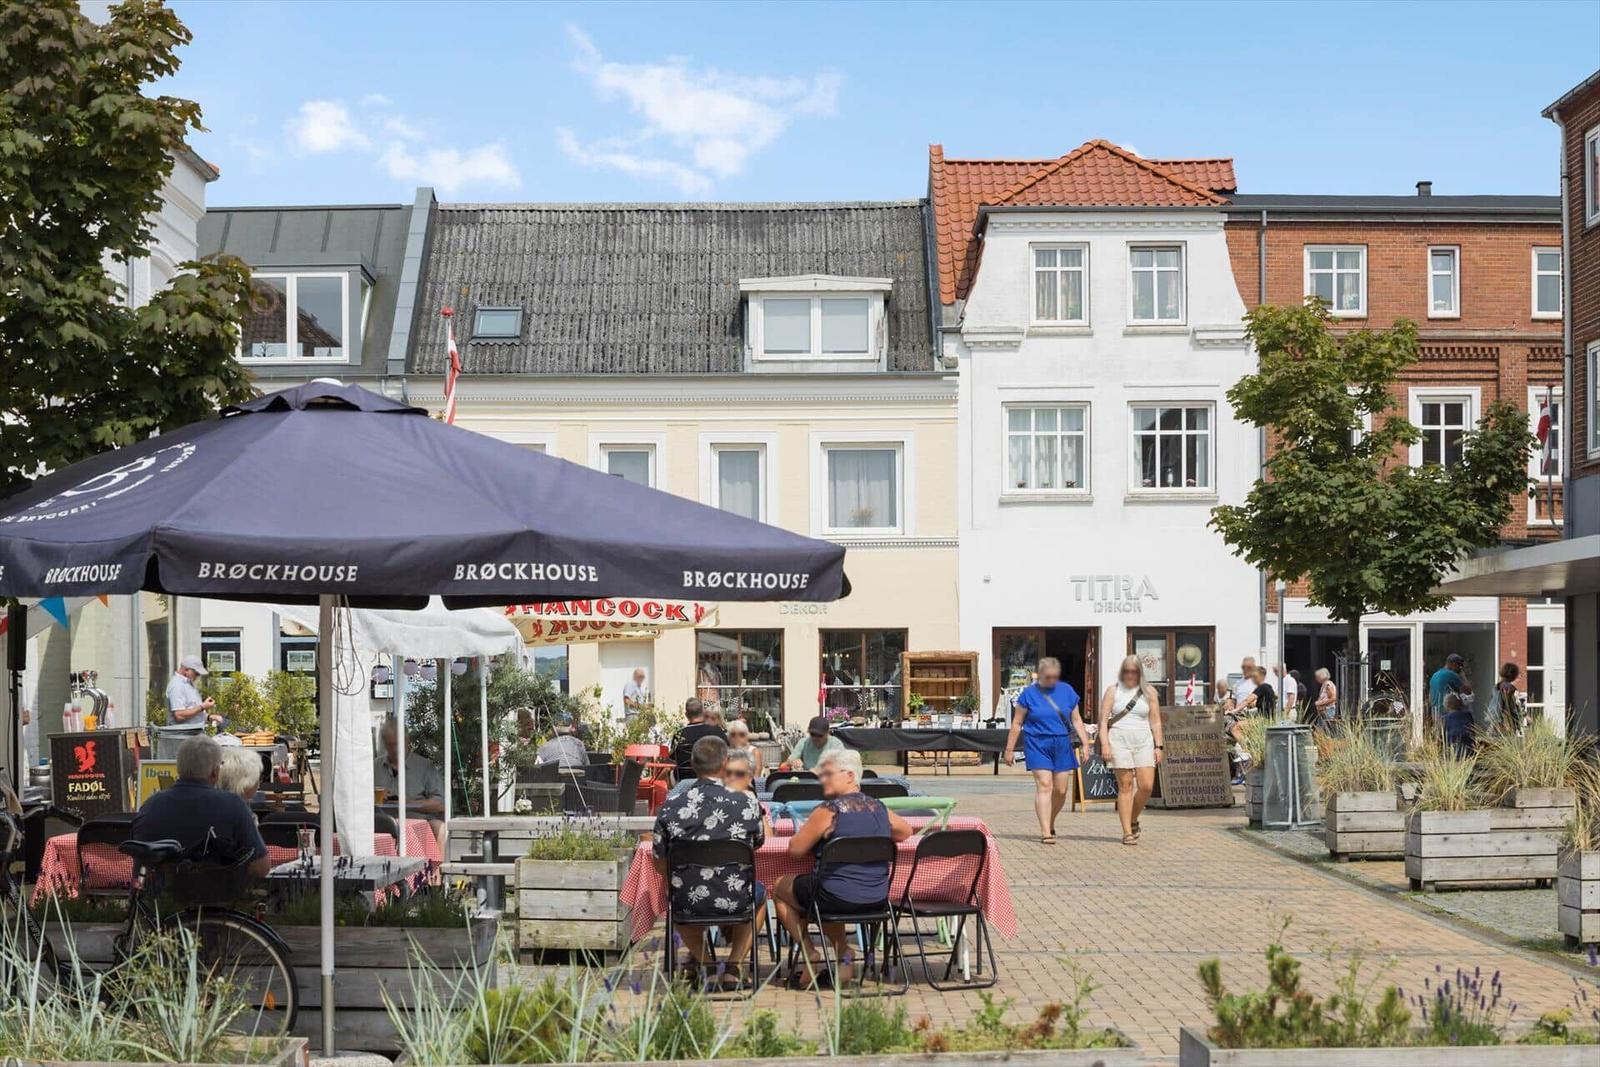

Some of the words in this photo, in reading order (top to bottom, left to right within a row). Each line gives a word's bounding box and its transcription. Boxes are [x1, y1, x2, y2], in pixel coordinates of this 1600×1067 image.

[45, 564, 122, 584] BRØCKHOUSE
[198, 562, 358, 582] BRØCKHOUSE
[454, 562, 599, 583] BRØCKHOUSE
[683, 570, 810, 590] BRØCKHOUSE
[1070, 575, 1160, 601] TITRA
[521, 598, 690, 622] HANCOCK
[1094, 601, 1142, 614] DEKOR
[68, 780, 106, 794] FADØL
